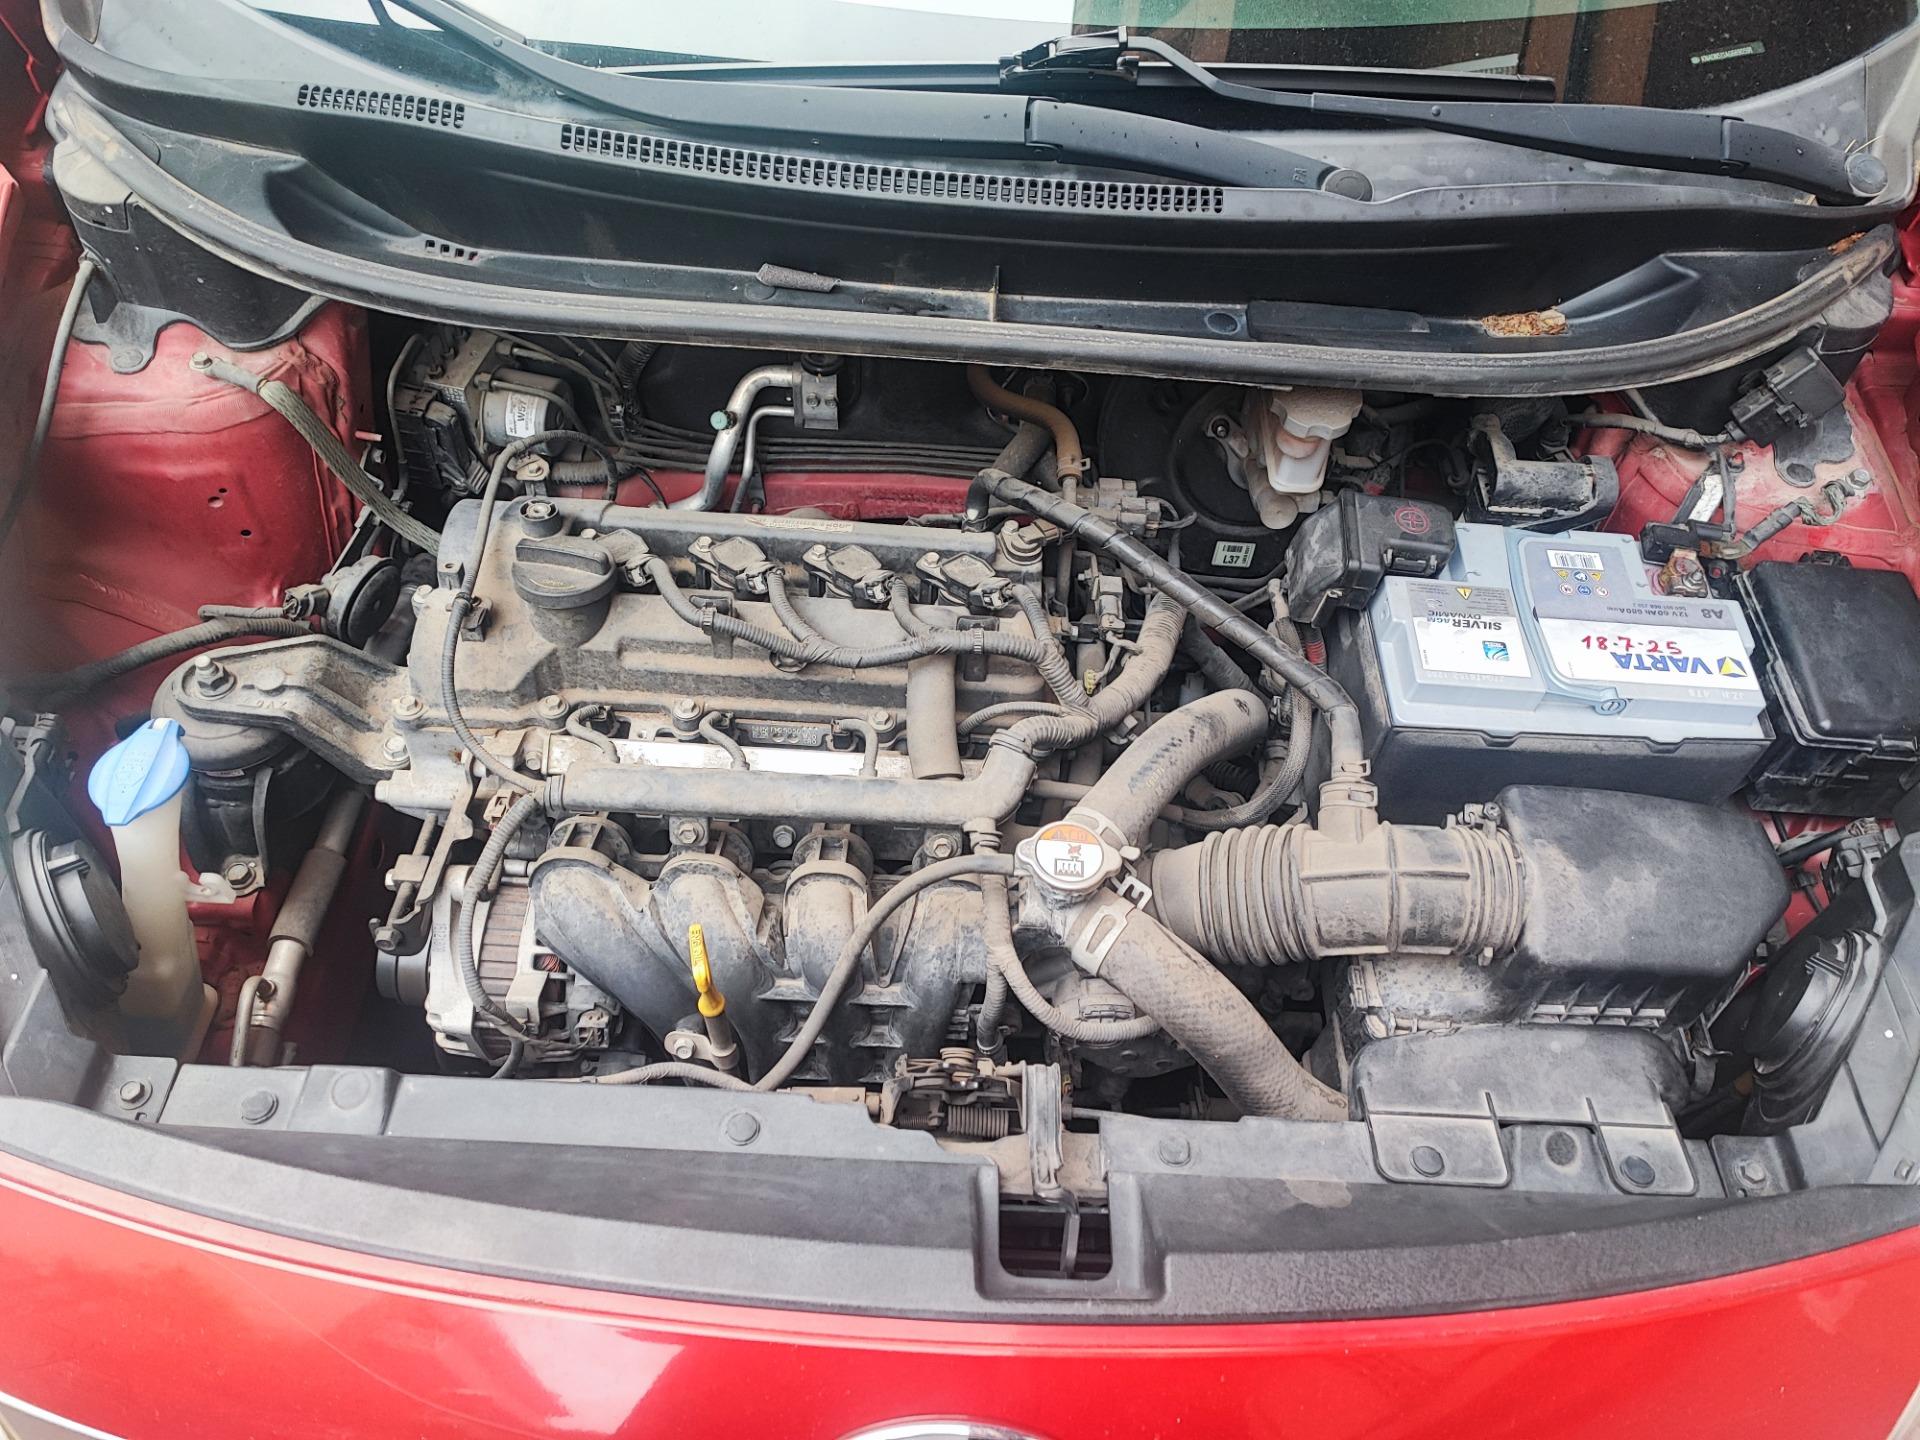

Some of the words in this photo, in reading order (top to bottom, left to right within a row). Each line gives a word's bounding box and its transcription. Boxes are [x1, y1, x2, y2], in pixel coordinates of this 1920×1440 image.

[1222, 554, 1240, 565] L37
[1428, 609, 1481, 620] DYNAMIC
[1701, 608, 1724, 620] A8
[1452, 618, 1502, 631] SILVER
[1610, 651, 1714, 675] VARTA
